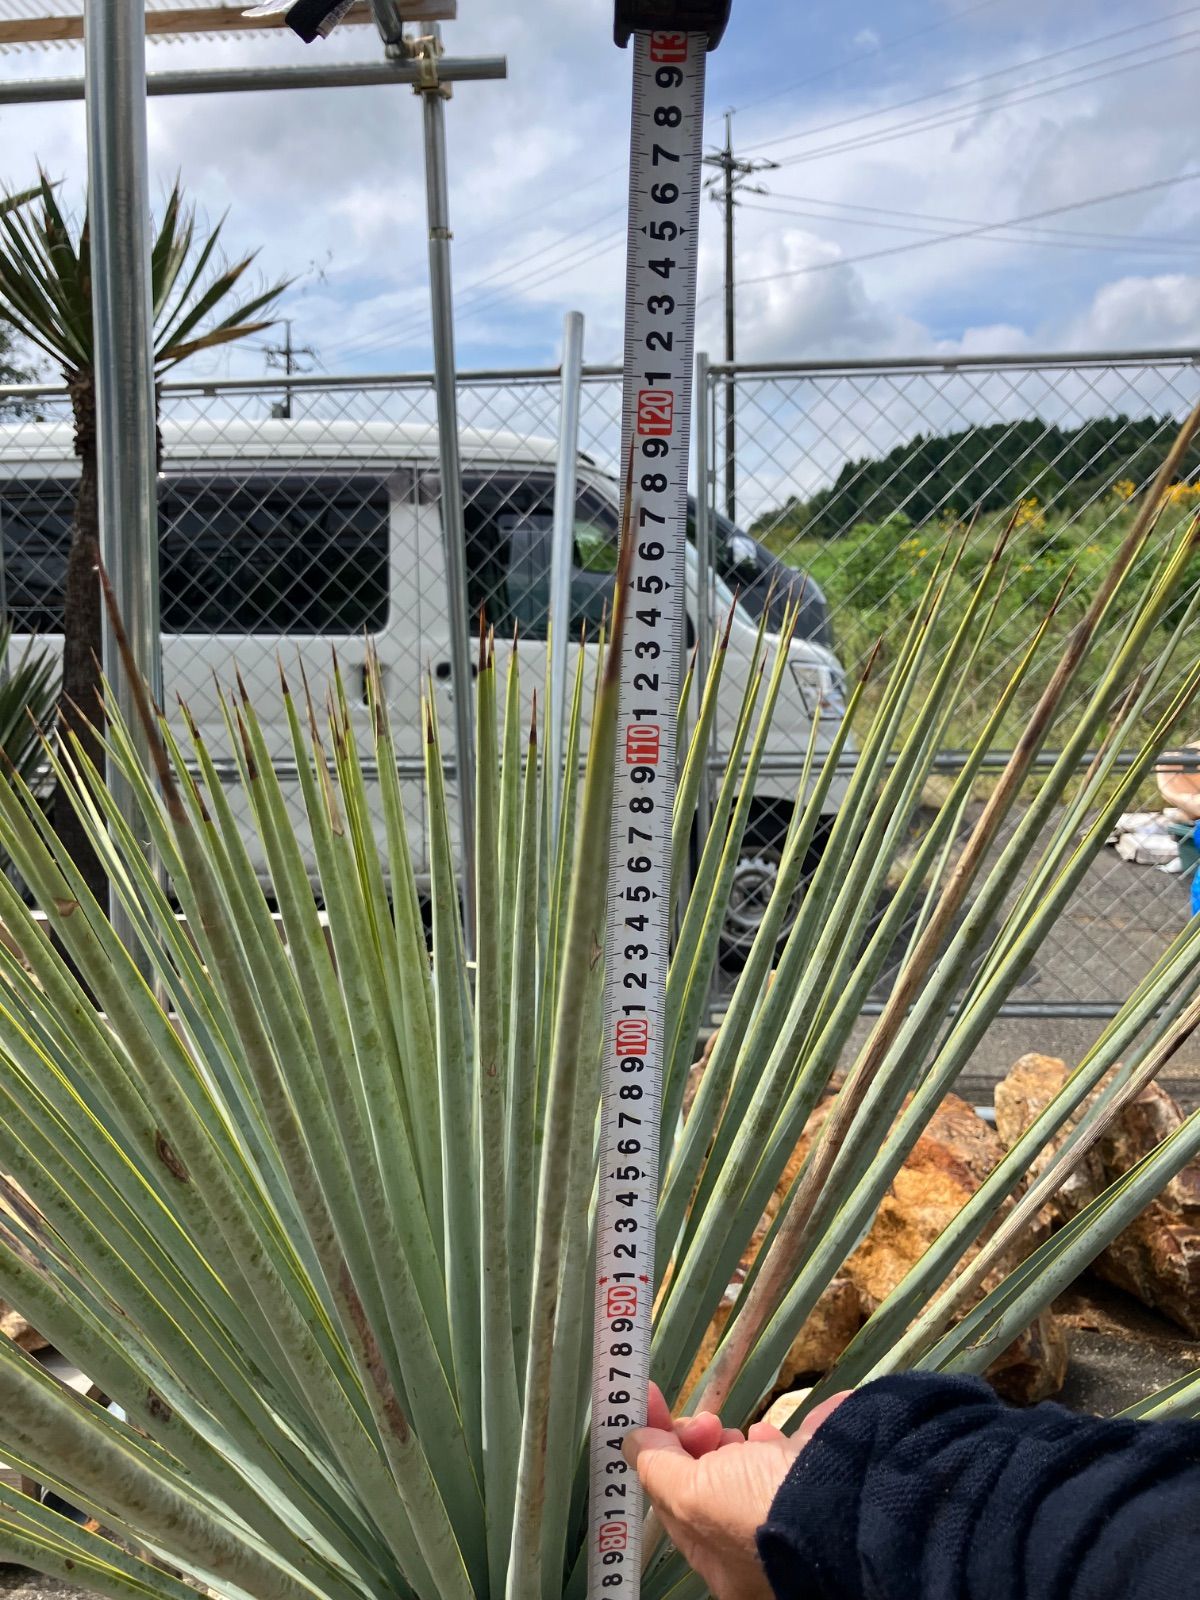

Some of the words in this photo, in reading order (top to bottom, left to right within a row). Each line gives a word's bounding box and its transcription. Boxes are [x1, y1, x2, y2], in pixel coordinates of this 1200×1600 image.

[655, 66, 683, 88] 9
[654, 106, 682, 127] 8
[651, 144, 680, 166] 7
[651, 183, 679, 204] 6
[650, 221, 677, 243] 5
[648, 257, 676, 279] 4
[647, 295, 675, 315] 3
[646, 331, 673, 352] 2
[644, 372, 671, 386] 1
[639, 392, 672, 433] 120
[642, 438, 669, 458] 9
[641, 473, 667, 493] 8
[639, 507, 665, 527] 7
[638, 541, 664, 560] 6
[637, 576, 663, 594] 5
[636, 608, 661, 627] 4
[635, 641, 660, 659] 3
[634, 674, 658, 691] 2
[632, 709, 657, 721] 1
[628, 726, 658, 762] 110
[630, 766, 655, 783] 9
[629, 797, 654, 814] 8
[628, 827, 652, 844] 7
[627, 857, 651, 872] 6
[626, 886, 650, 902] 5
[625, 915, 648, 931] 4
[624, 944, 648, 960] 3
[623, 973, 647, 989] 2
[622, 1004, 646, 1016] 1
[617, 1020, 647, 1054] 100
[620, 1056, 644, 1072] 9
[620, 1085, 643, 1100] 8
[618, 1113, 641, 1129] 7
[617, 1139, 641, 1154] 6
[617, 1166, 639, 1181] 5
[615, 1192, 638, 1207] 4
[615, 1218, 637, 1232] 3
[614, 1244, 636, 1258] 2
[613, 1272, 635, 1282] 1
[608, 1286, 636, 1316] 90
[611, 1318, 633, 1332] 9
[610, 1342, 632, 1356] 8
[609, 1367, 631, 1381] 7
[608, 1390, 630, 1404] 6
[607, 1414, 629, 1427] 5
[606, 1437, 624, 1450] 4
[605, 1461, 627, 1474] 3
[604, 1484, 626, 1497] 2
[604, 1510, 625, 1519] 1
[601, 1522, 627, 1550] 80
[603, 1551, 624, 1565] 9
[602, 1573, 622, 1587] 8
